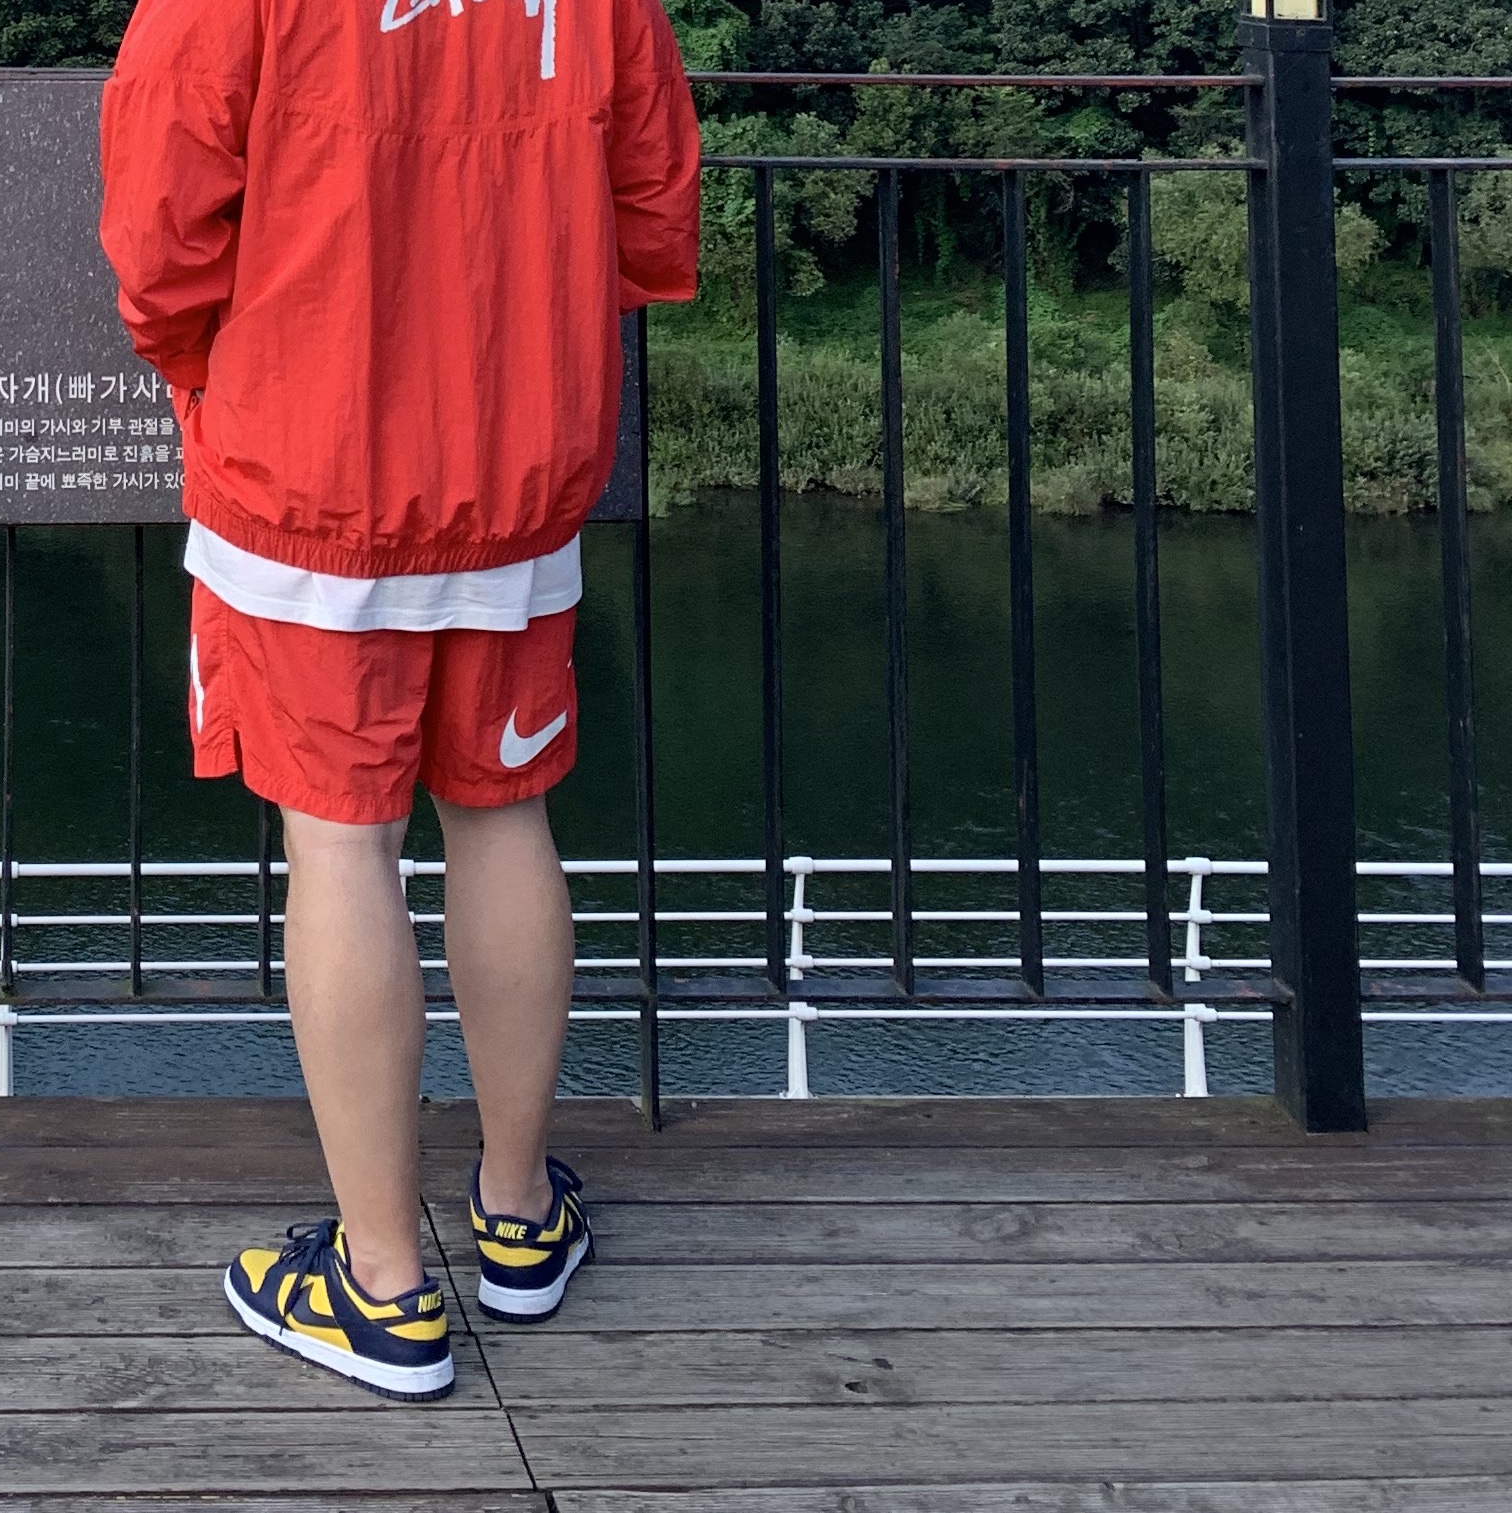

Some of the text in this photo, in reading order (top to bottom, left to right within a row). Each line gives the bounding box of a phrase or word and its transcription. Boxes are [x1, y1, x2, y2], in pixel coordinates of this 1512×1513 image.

[39, 418, 87, 437] 가시와
[91, 417, 124, 436] 기부
[127, 417, 176, 436] 관절을
[8, 445, 119, 464] 가슴지느러미로
[122, 444, 171, 463] 진흙을
[24, 472, 56, 490] 끝에
[61, 472, 108, 490] 뾰족한
[112, 471, 160, 490] 가시가
[494, 1221, 528, 1240] NIKE
[417, 1289, 442, 1314] NIKE
